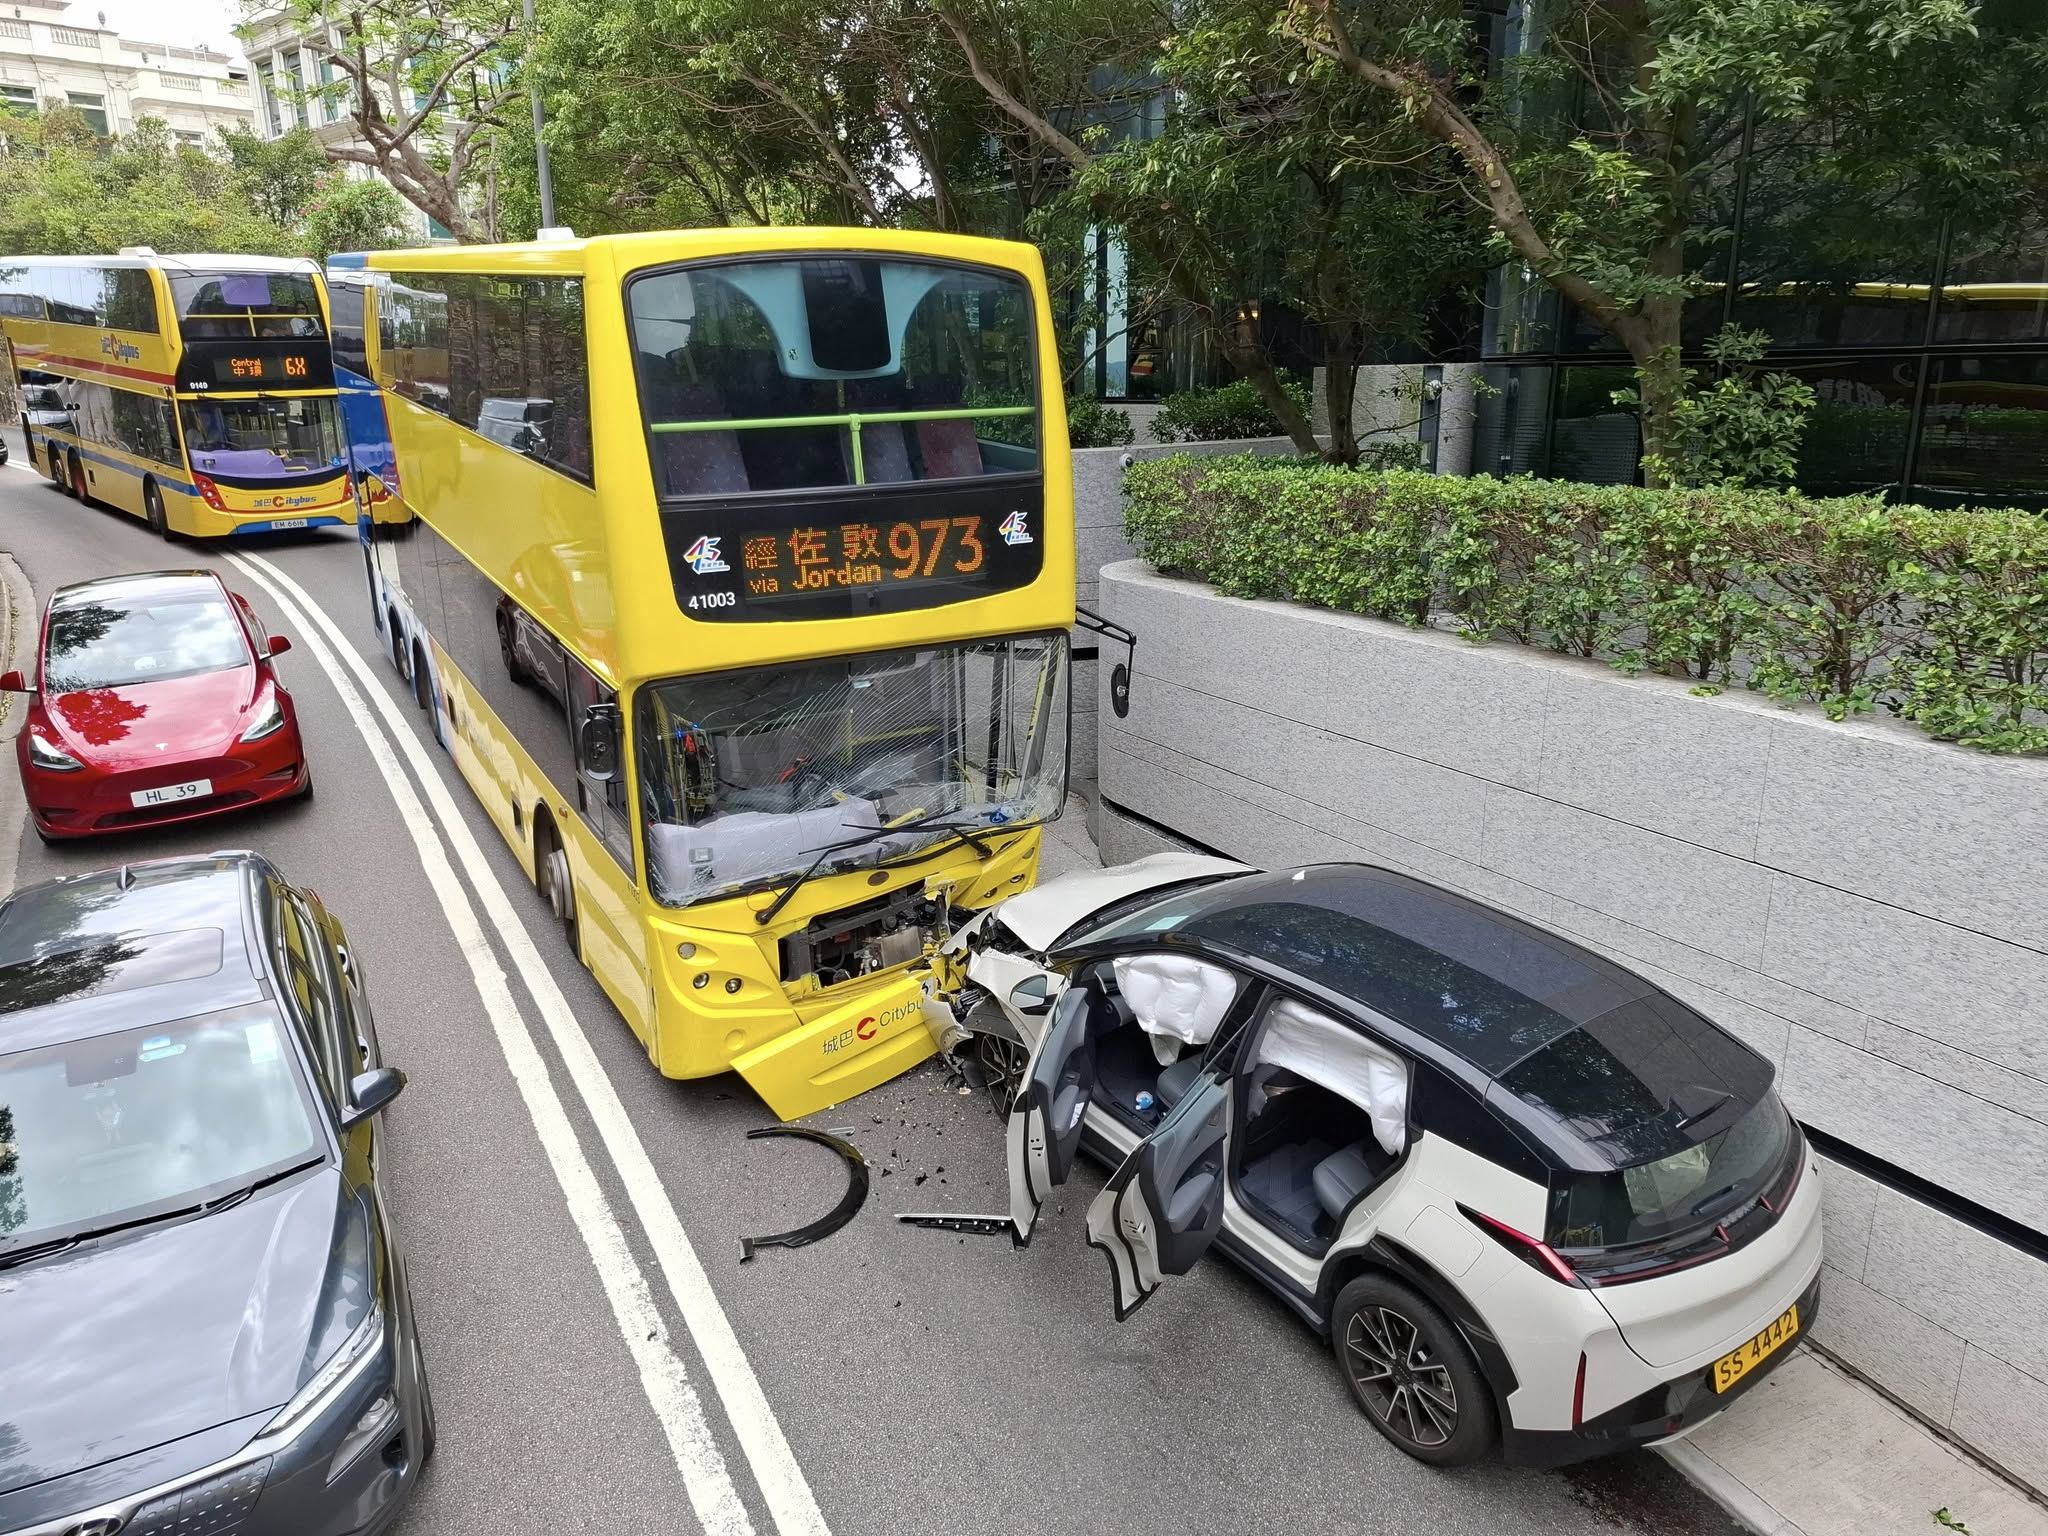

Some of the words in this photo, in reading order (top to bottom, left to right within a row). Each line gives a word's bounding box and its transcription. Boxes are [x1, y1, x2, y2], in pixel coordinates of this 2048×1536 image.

[231, 358, 262, 367] Central
[285, 357, 306, 375] 6X
[787, 523, 881, 566] 佐敦
[889, 516, 983, 579] 973
[750, 573, 779, 593] via
[793, 561, 881, 590] Jordan
[689, 592, 736, 610] 41003
[146, 790, 169, 803] HL
[176, 784, 197, 798] 39
[823, 1029, 854, 1055] 城巴
[880, 998, 923, 1027] Citybu
[1720, 1351, 1743, 1384] SS
[1751, 1310, 1794, 1358] 4442
